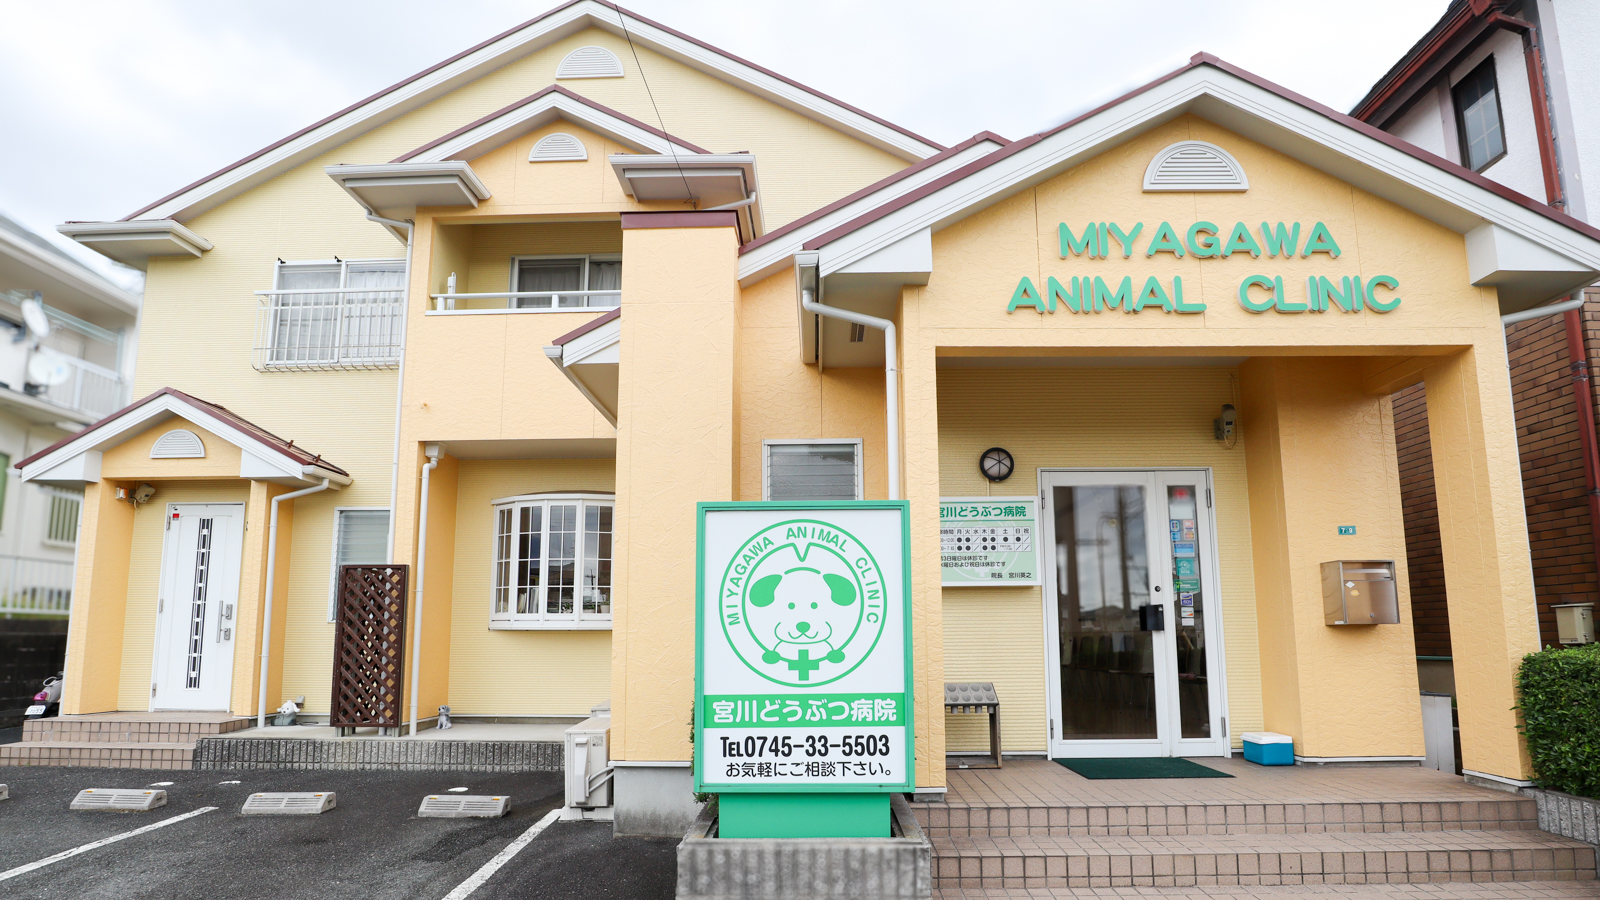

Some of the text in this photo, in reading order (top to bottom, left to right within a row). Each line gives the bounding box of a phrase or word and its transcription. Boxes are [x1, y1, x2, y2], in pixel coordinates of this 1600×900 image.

[1058, 221, 1341, 259] MIYAGAWA
[1006, 274, 1401, 314] ANIMAL CLINIC
[726, 526, 880, 626] MIYAGAWA ANIMAL CLINIC
[712, 698, 897, 723] 宮川どうぶつ病院
[725, 761, 892, 778] お気軽にご相談下さい。
